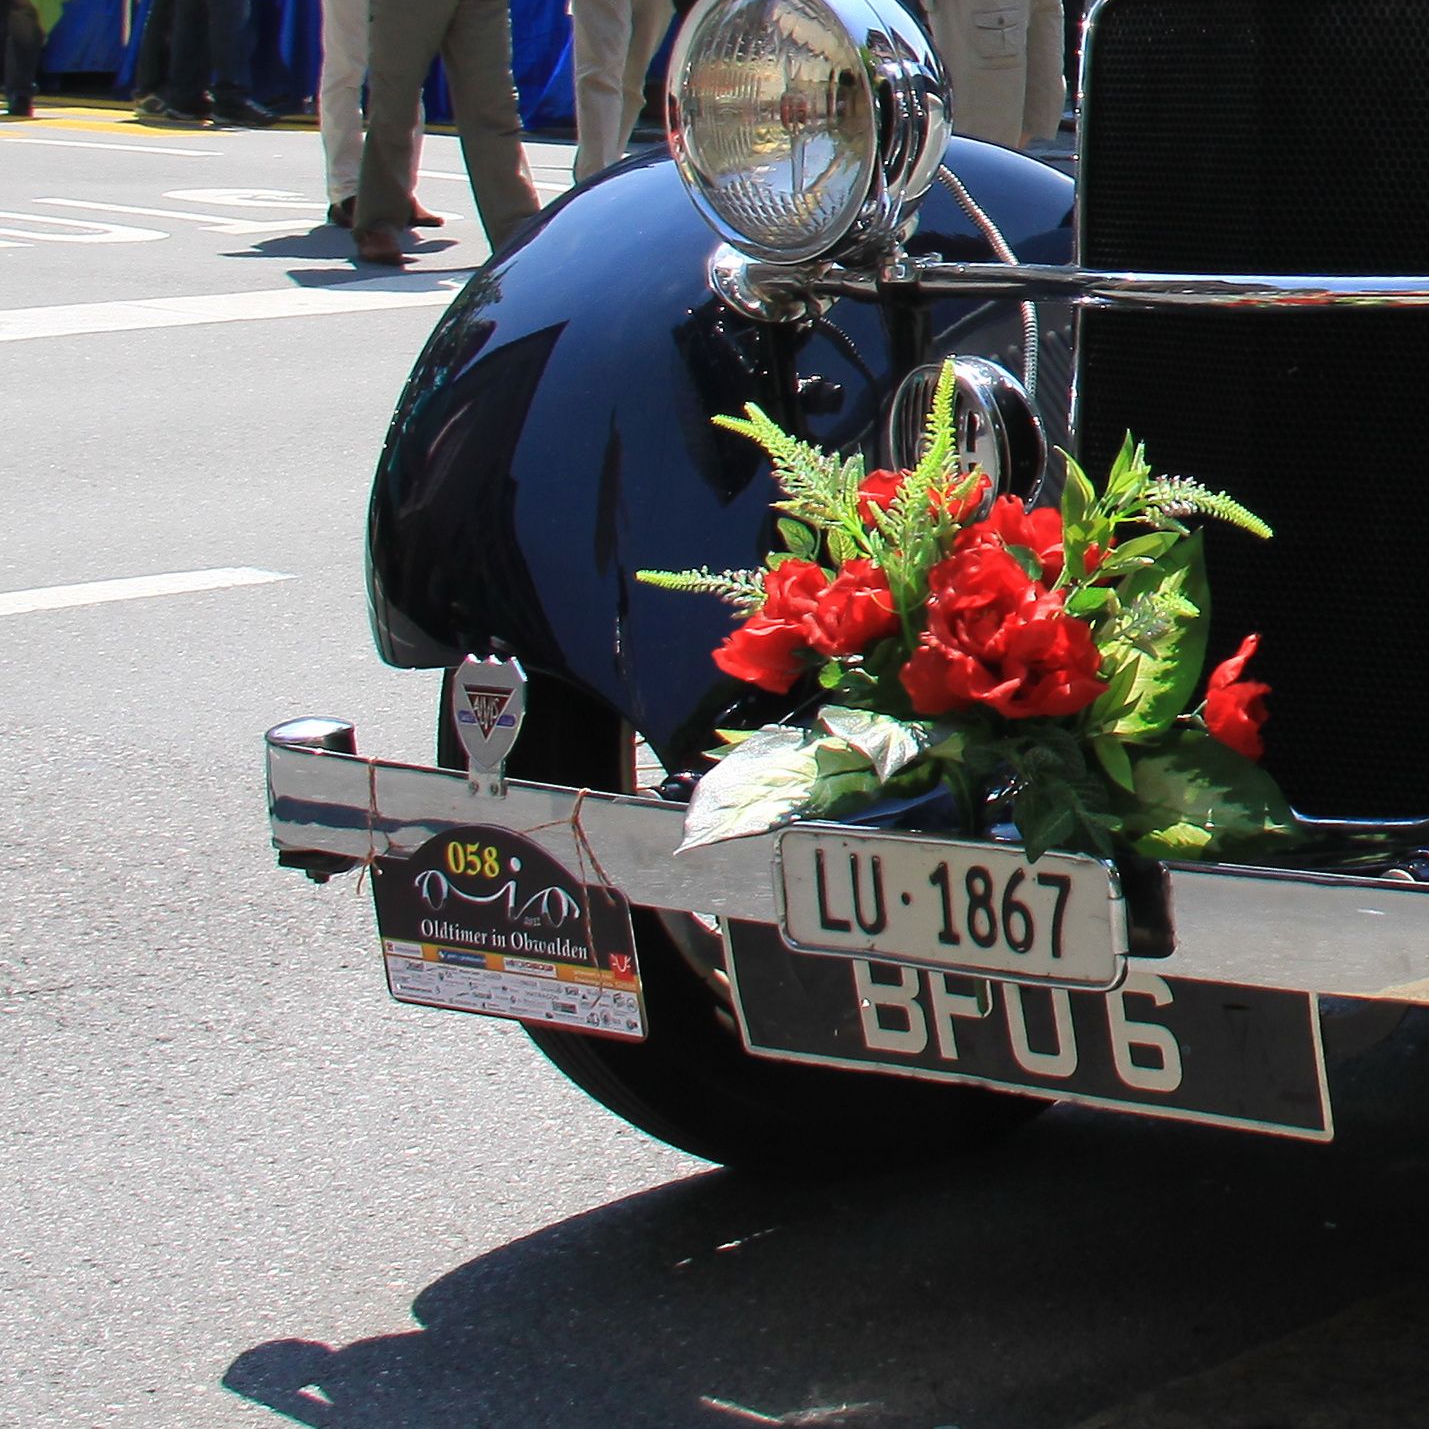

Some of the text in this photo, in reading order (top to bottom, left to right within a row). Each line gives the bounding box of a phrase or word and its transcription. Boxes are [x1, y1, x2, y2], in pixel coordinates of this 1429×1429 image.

[447, 840, 500, 879] 058
[420, 917, 488, 946] Oldtimer
[491, 928, 507, 949] in
[510, 931, 588, 961] Obwalden
[1105, 971, 1183, 1093] 6
